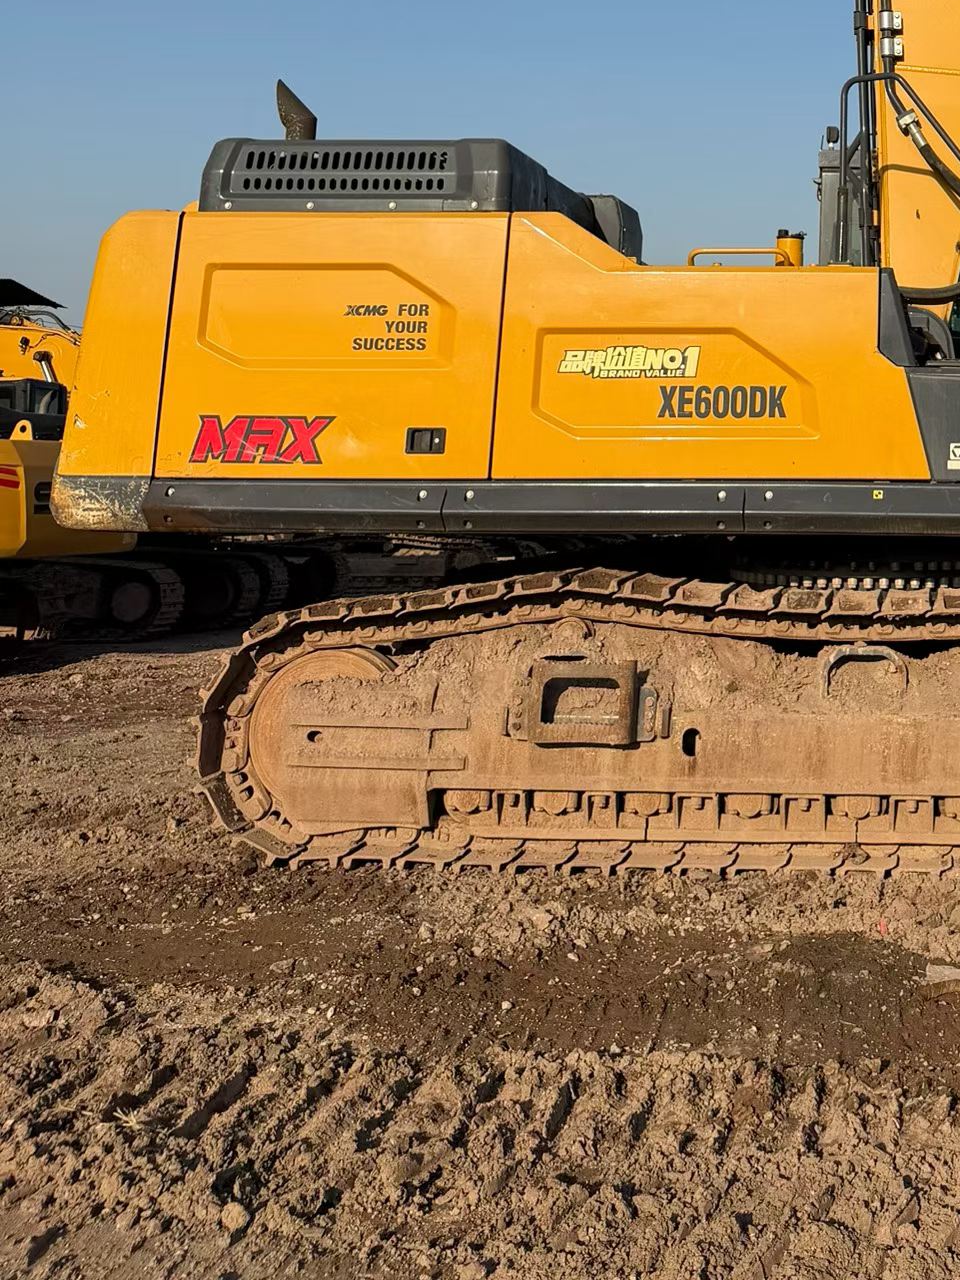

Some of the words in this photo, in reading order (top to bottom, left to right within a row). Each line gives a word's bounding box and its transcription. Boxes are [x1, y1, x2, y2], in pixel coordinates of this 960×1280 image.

[343, 305, 389, 317] XCMG
[397, 304, 430, 317] FOR
[384, 320, 429, 334] YOUR
[352, 337, 428, 351] SUCCESS
[600, 369, 641, 378] BRAND
[645, 369, 685, 378] VALUE
[657, 385, 788, 419] XE600DK
[188, 414, 337, 464] MAX
